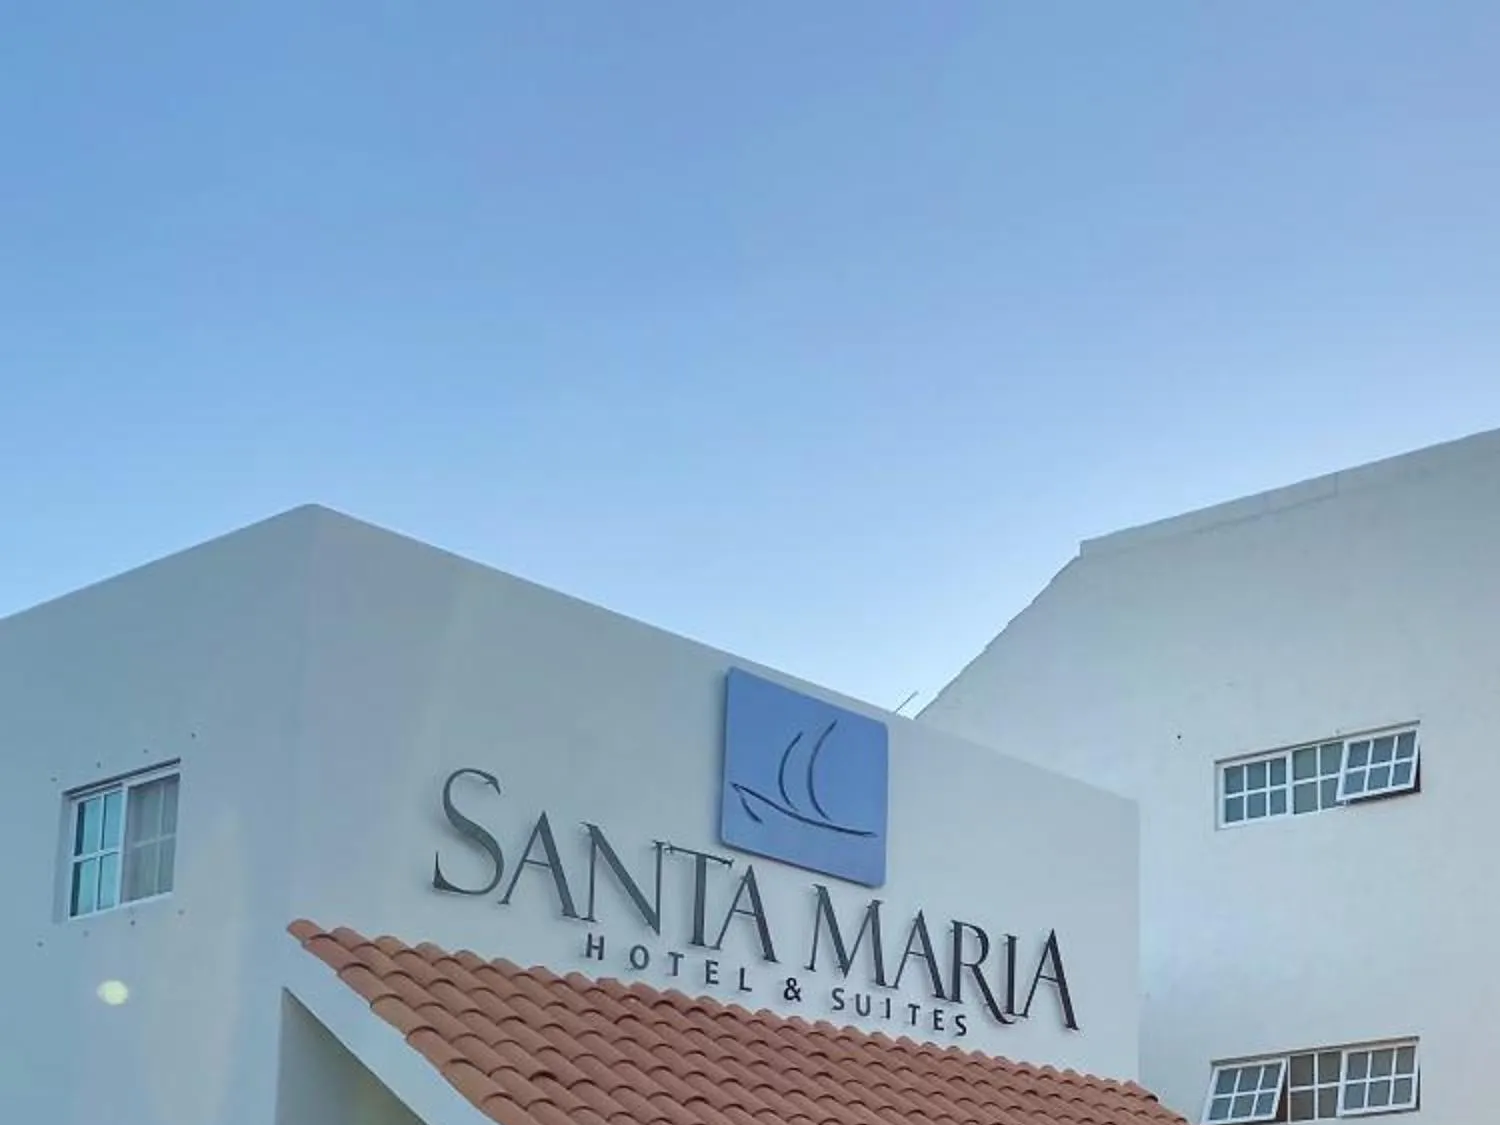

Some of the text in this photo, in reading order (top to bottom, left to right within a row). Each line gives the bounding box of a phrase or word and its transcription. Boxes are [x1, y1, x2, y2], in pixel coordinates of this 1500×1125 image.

[432, 767, 1079, 1031] SANTA MARIA
[585, 933, 968, 1036] HOTEL & SUITES
